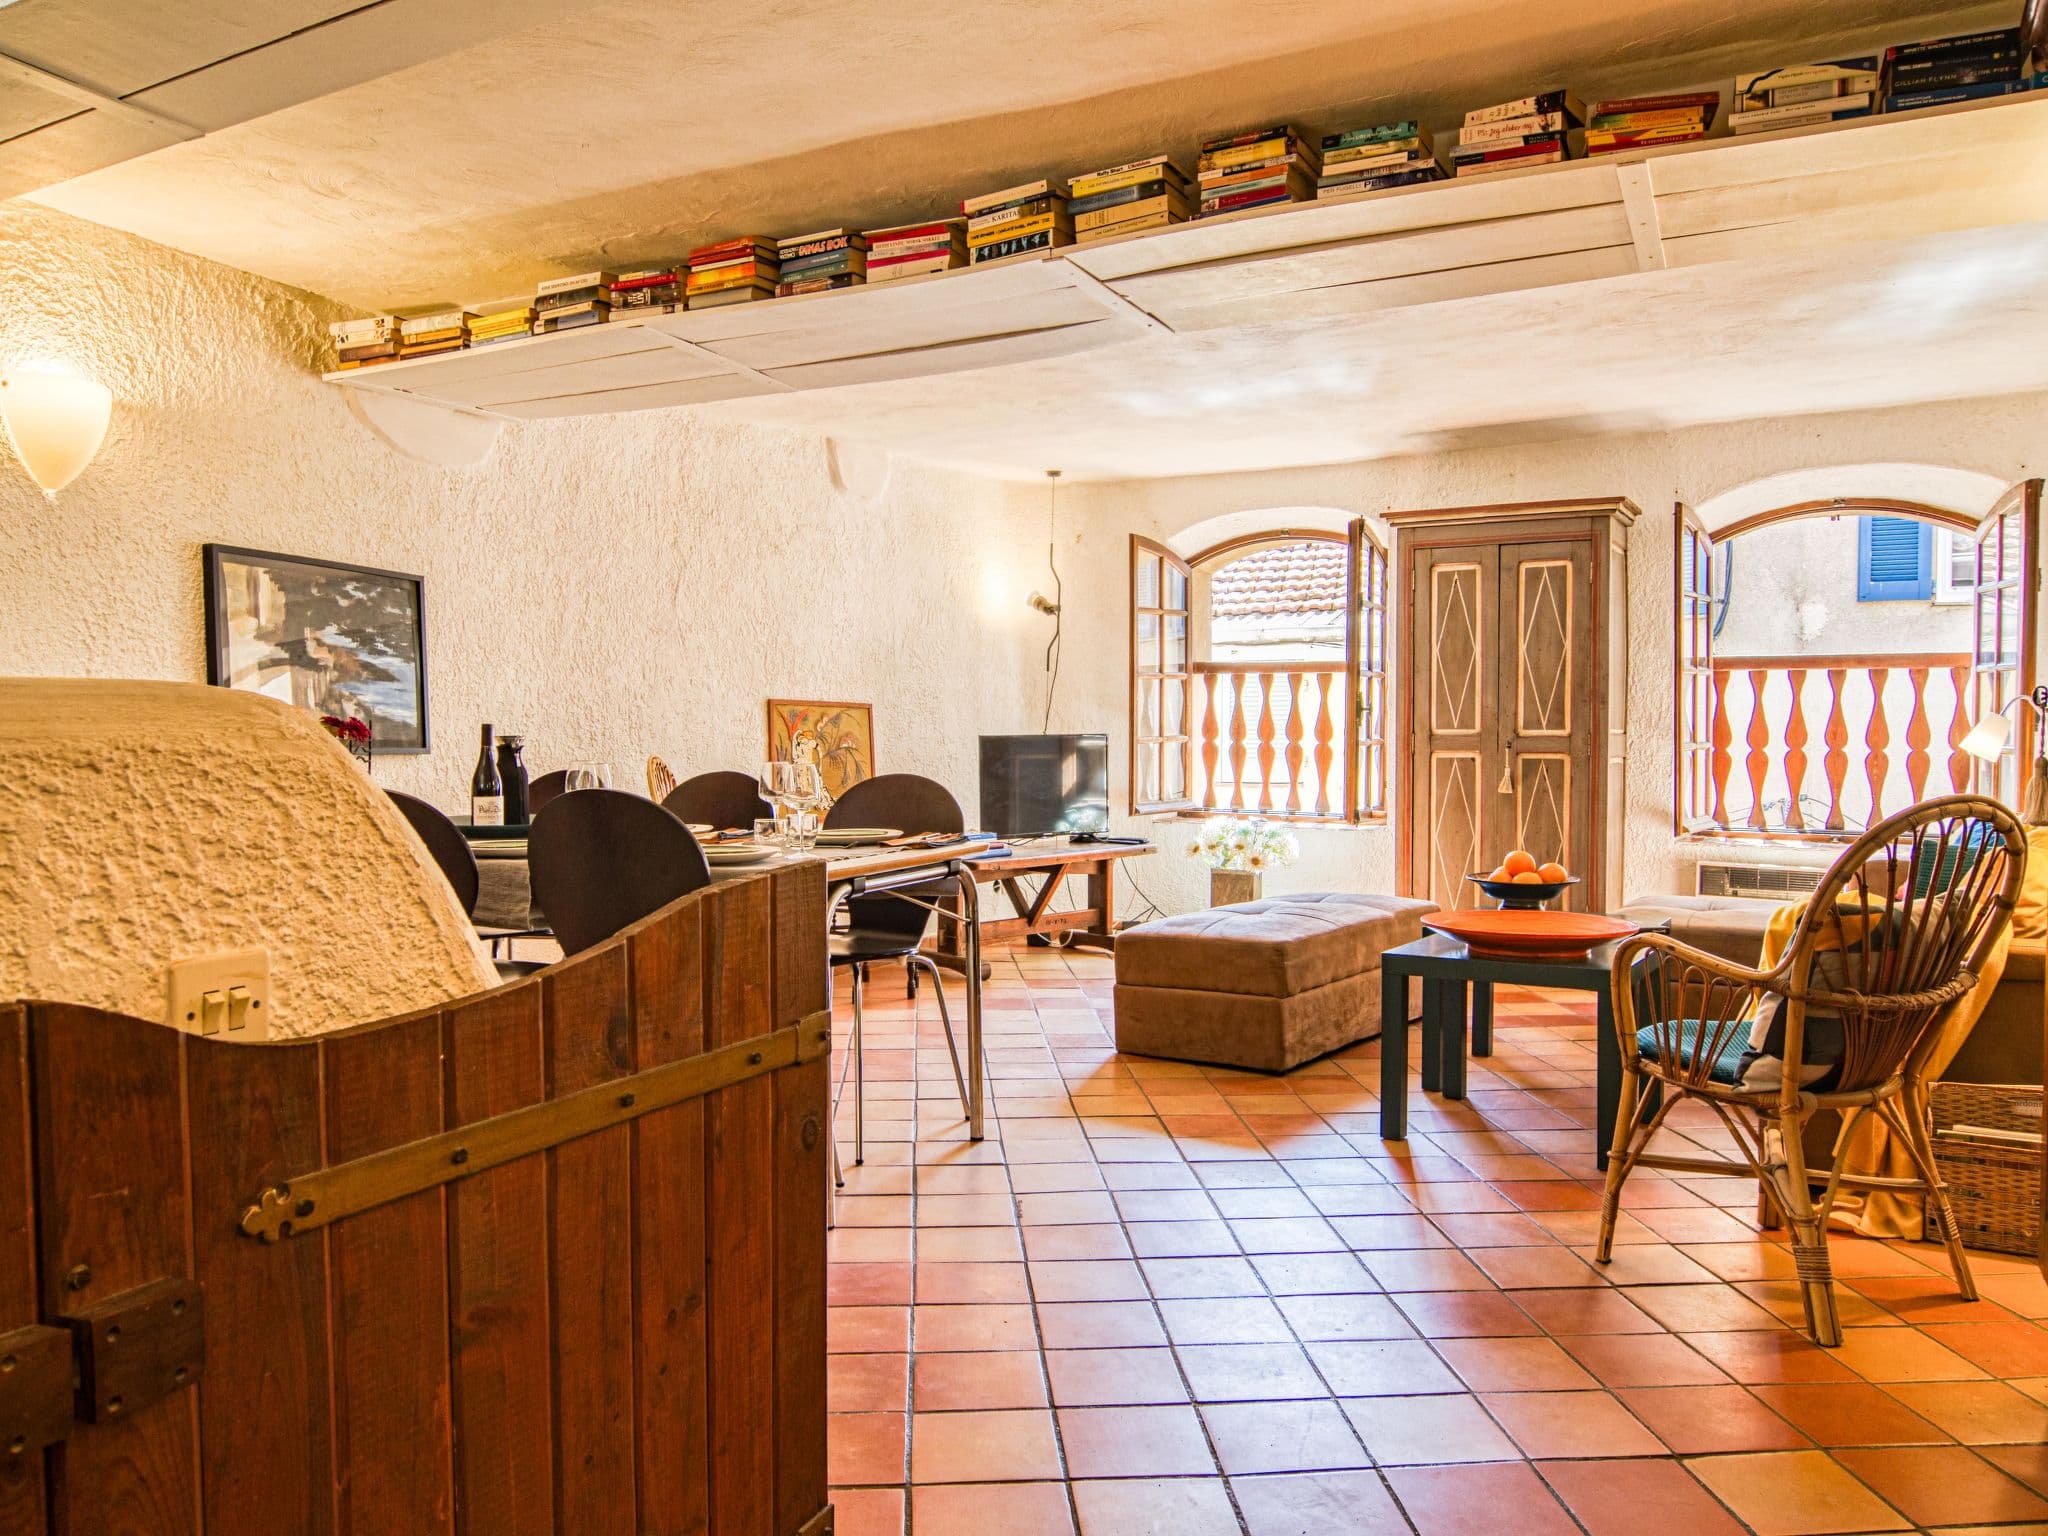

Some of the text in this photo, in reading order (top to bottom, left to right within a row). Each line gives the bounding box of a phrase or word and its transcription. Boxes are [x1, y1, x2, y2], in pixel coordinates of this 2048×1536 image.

[1928, 73, 1957, 83] FLYNN
[991, 207, 1023, 222] KARITAS
[799, 236, 848, 257] DINAS BOK
